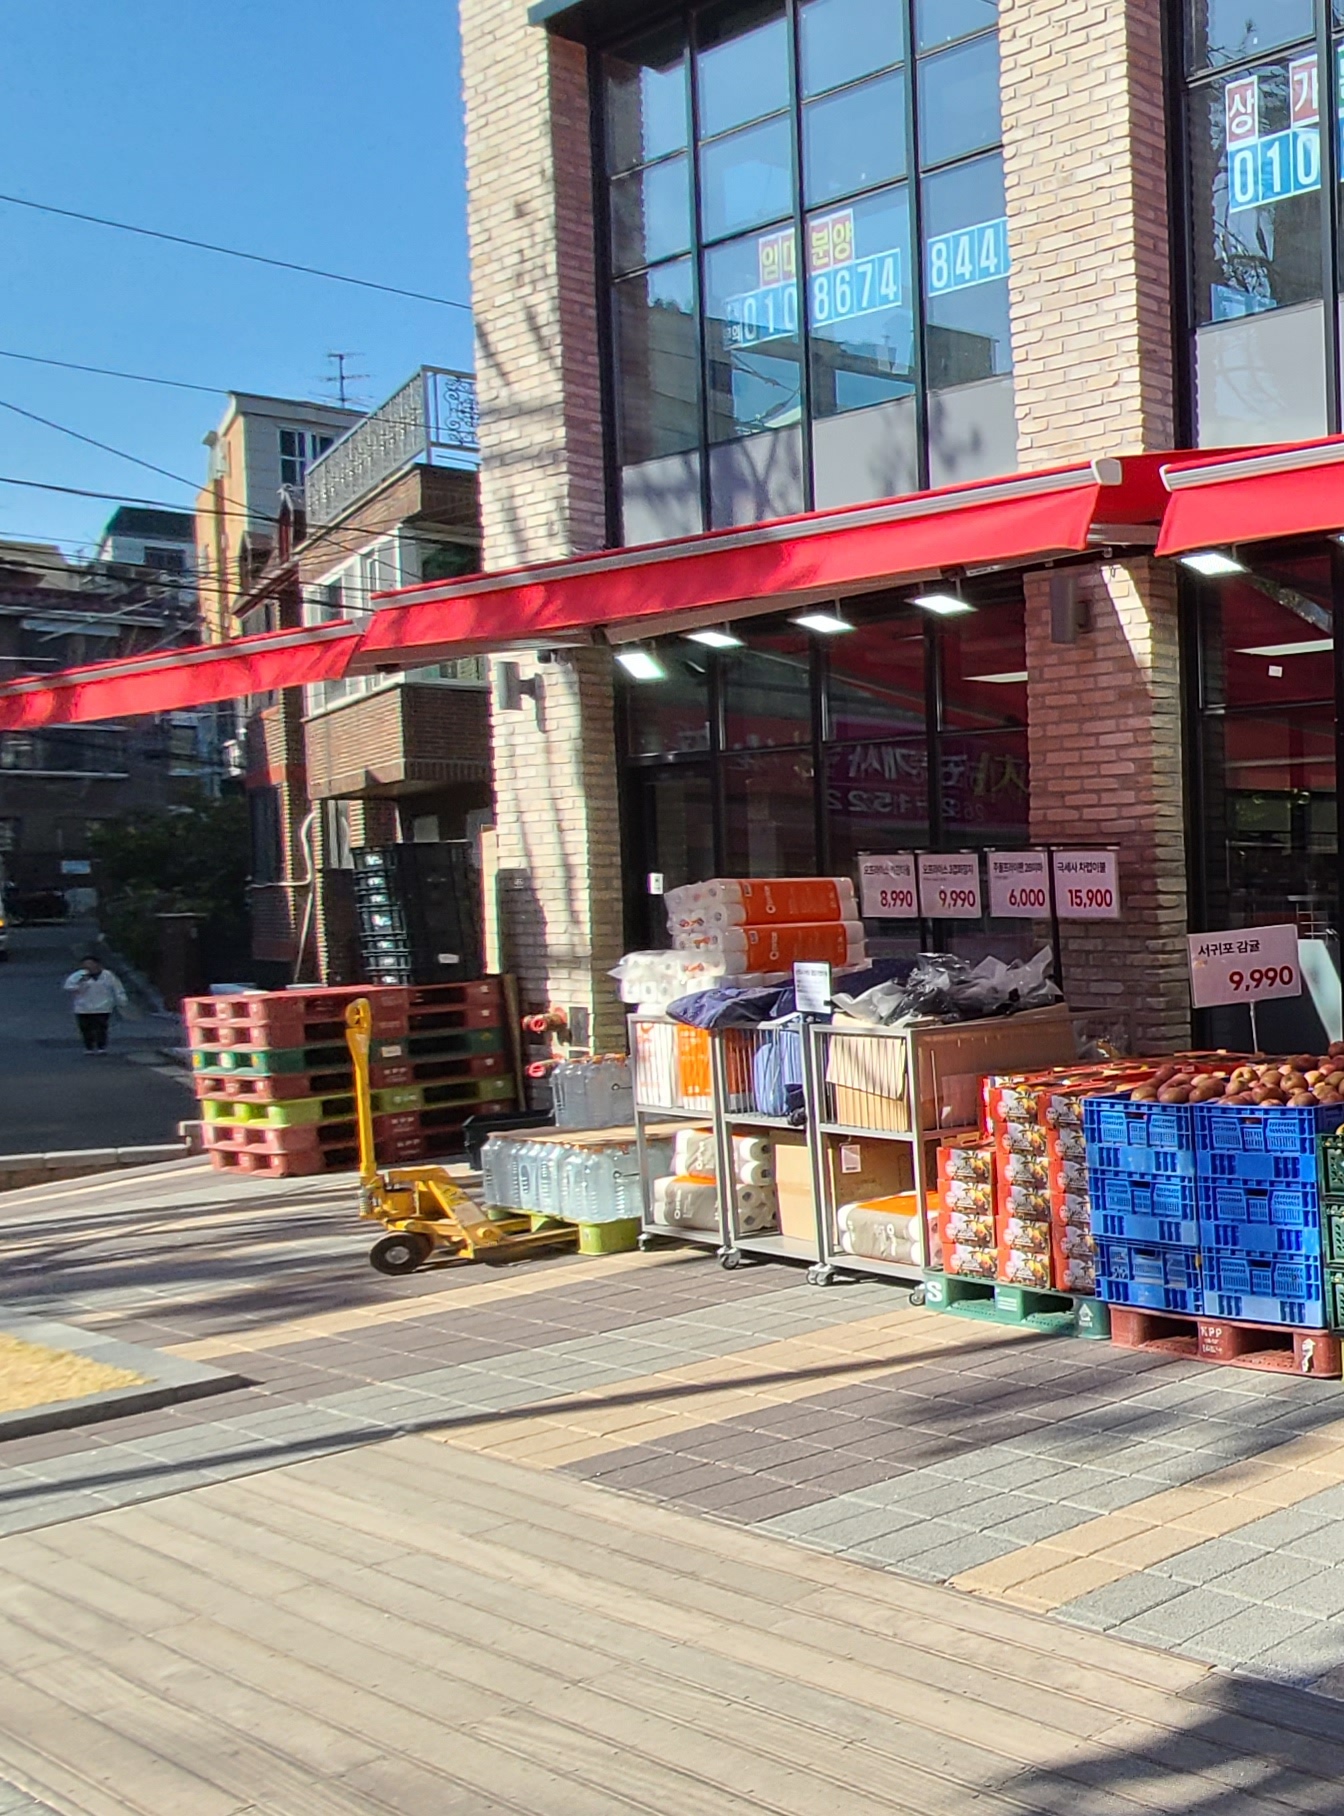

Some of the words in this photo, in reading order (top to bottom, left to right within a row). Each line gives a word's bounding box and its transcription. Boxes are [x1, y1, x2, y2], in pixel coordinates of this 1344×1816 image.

[1232, 130, 1318, 204] 010
[811, 222, 853, 265] 분양
[814, 258, 897, 321] 8674
[930, 227, 1000, 288] 844
[1057, 862, 1077, 874] 극세사
[880, 889, 913, 908] 8,990
[939, 889, 976, 908] 9,990
[1009, 888, 1045, 908] 6,000
[1068, 888, 1113, 908] 15,900
[1198, 941, 1234, 957] 서귀포
[1237, 939, 1261, 953] 감귤
[1228, 966, 1293, 992] 9,990
[927, 1281, 942, 1302] S
